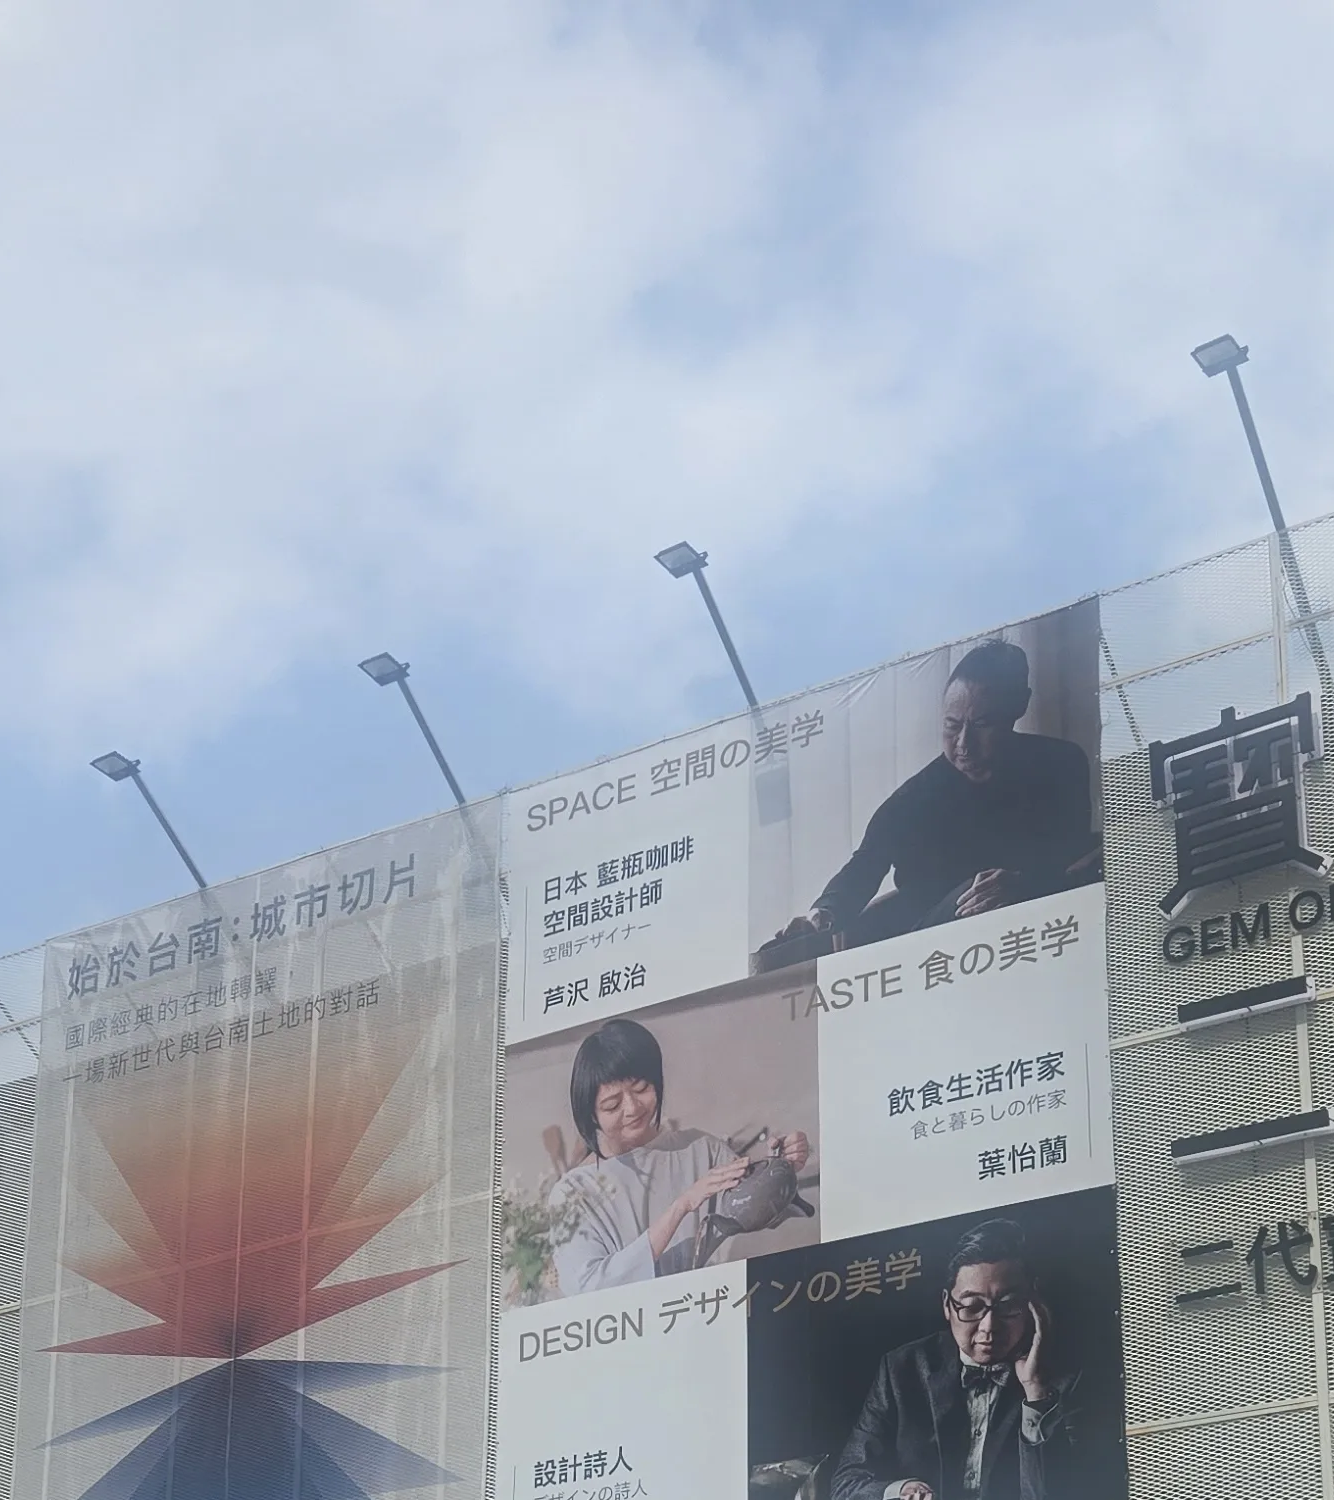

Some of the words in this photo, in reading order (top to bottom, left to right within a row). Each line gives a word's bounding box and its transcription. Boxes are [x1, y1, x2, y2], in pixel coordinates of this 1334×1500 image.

[526, 773, 636, 833] SPACE
[649, 709, 825, 798] 空間の美学
[544, 870, 587, 904] 日本
[597, 835, 694, 888] 藍瓶咖啡
[543, 878, 663, 938] 空間設計師
[1162, 903, 1271, 963] GEM
[543, 923, 652, 964] 空間デザイナー
[782, 964, 903, 1021] TASTE
[917, 914, 1080, 991] 食の美学
[887, 1051, 1065, 1117] 飲食生活作家
[910, 1089, 1067, 1140] 食と暮らしの作家
[978, 1135, 1067, 1180] 葉怡蘭
[519, 1308, 644, 1362] DESIGN
[658, 1248, 923, 1335] デザインの美学
[534, 1445, 633, 1488] 設計詩人
